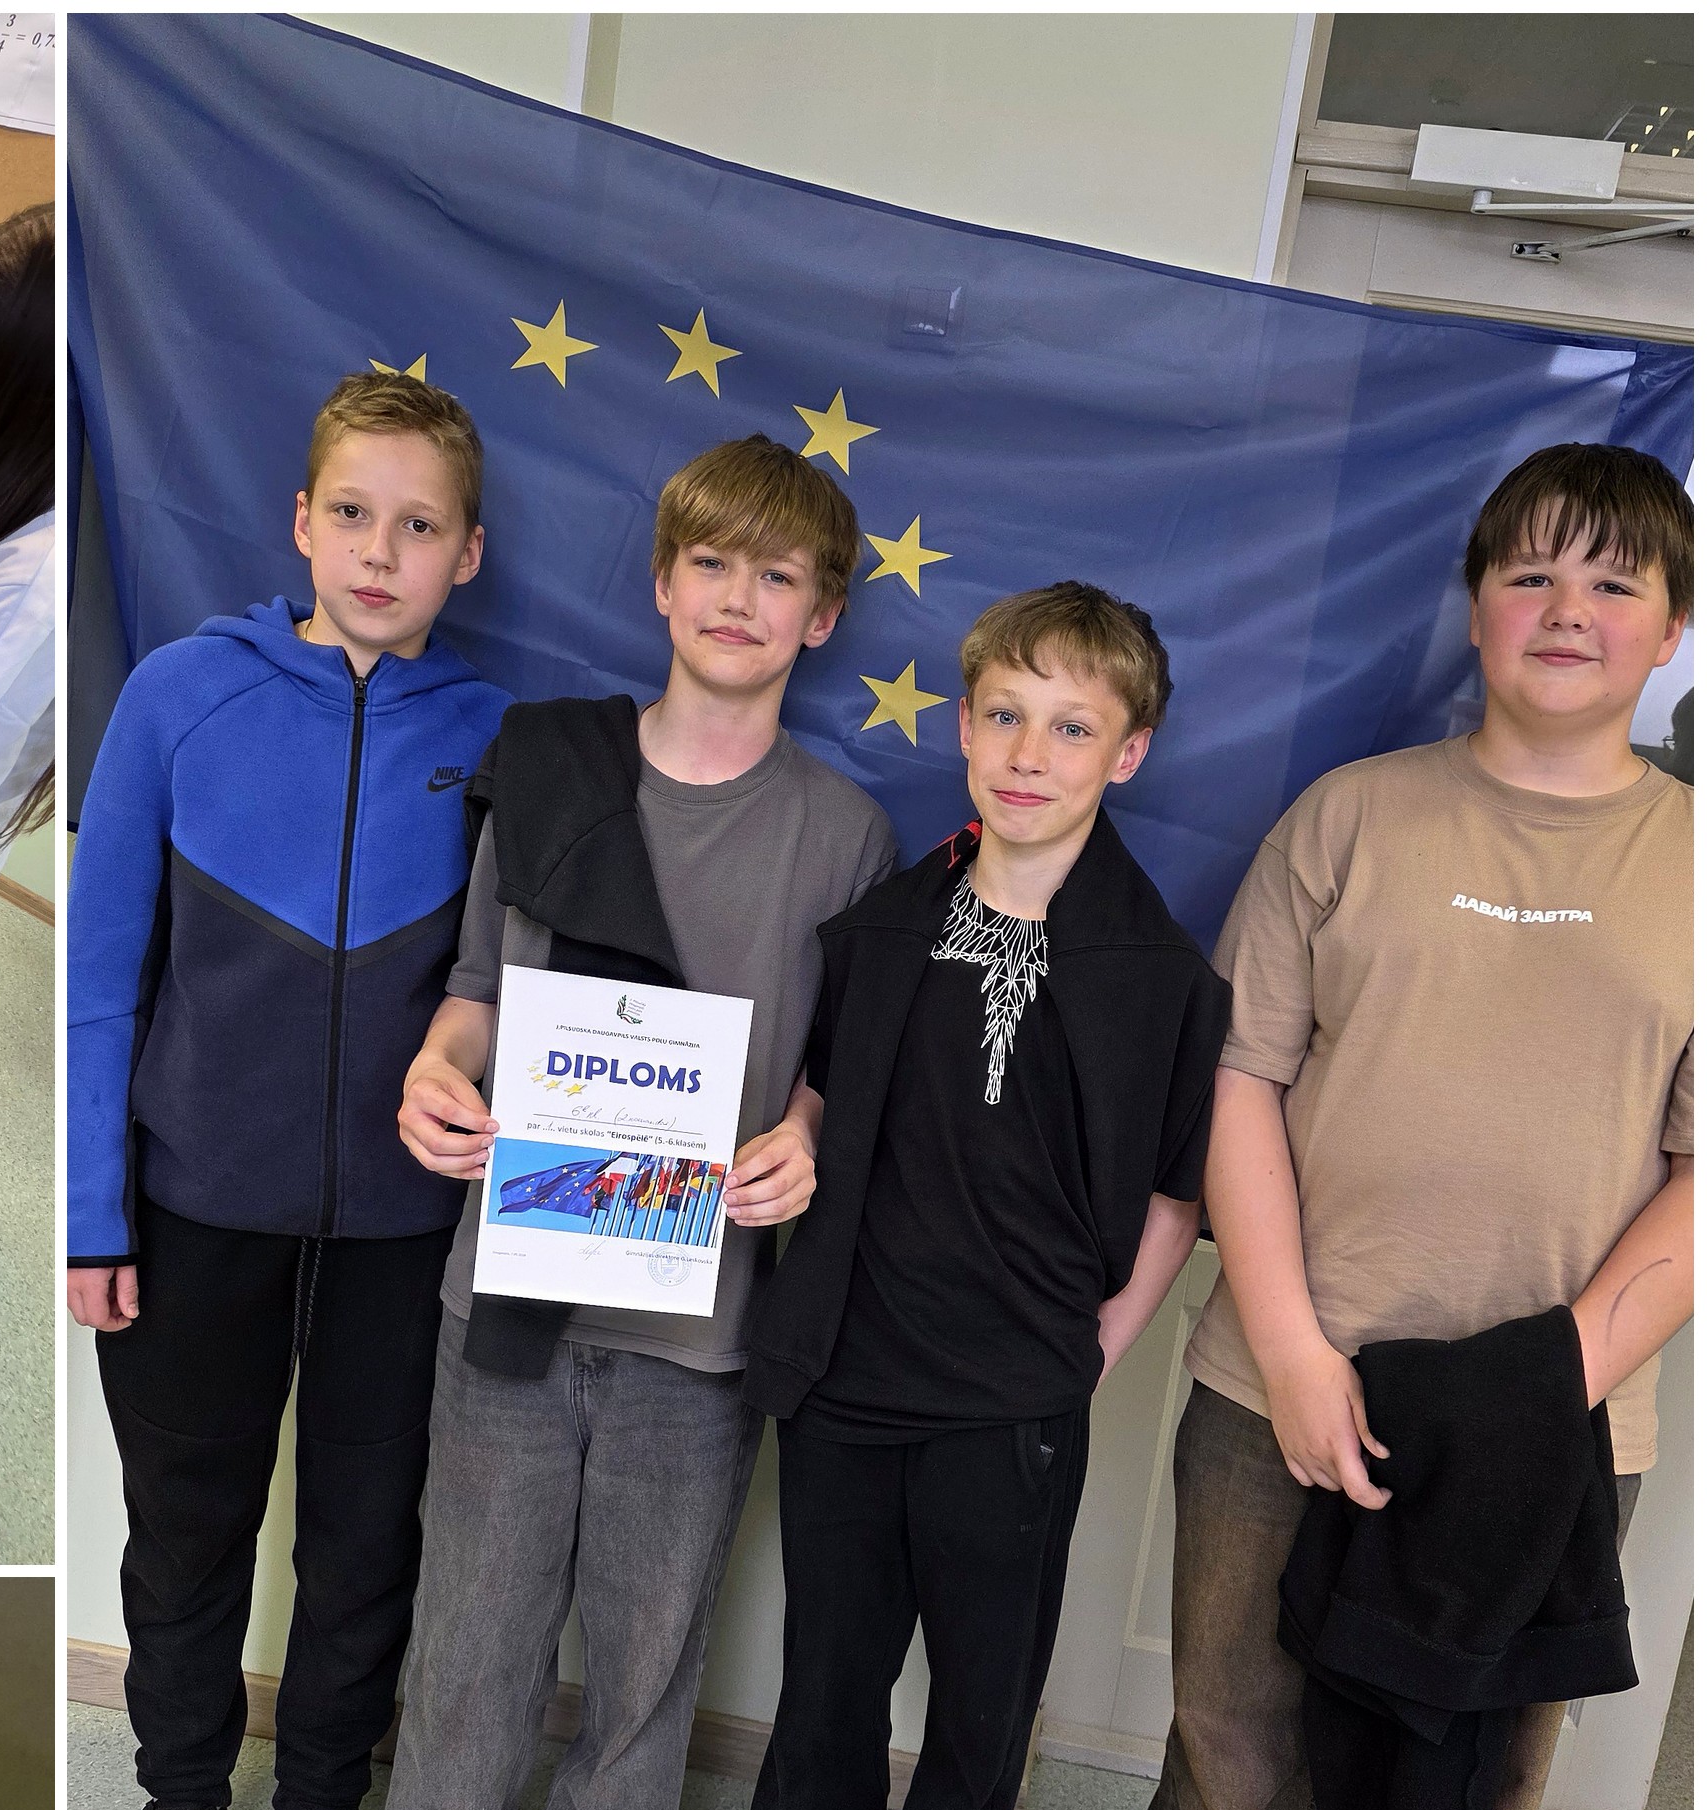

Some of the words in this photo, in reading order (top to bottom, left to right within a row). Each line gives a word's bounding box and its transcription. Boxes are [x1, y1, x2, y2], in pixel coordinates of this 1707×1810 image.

[6, 13, 17, 27] 3
[31, 32, 55, 49] 0,7
[434, 766, 465, 781] NIKE
[1451, 893, 1519, 923] ДАВАЙ
[1519, 909, 1594, 924] ЗАВТРА
[547, 1050, 702, 1094] DIPLOMS
[526, 1121, 541, 1131] par
[557, 1125, 578, 1135] vietu
[579, 1127, 605, 1138] skolas
